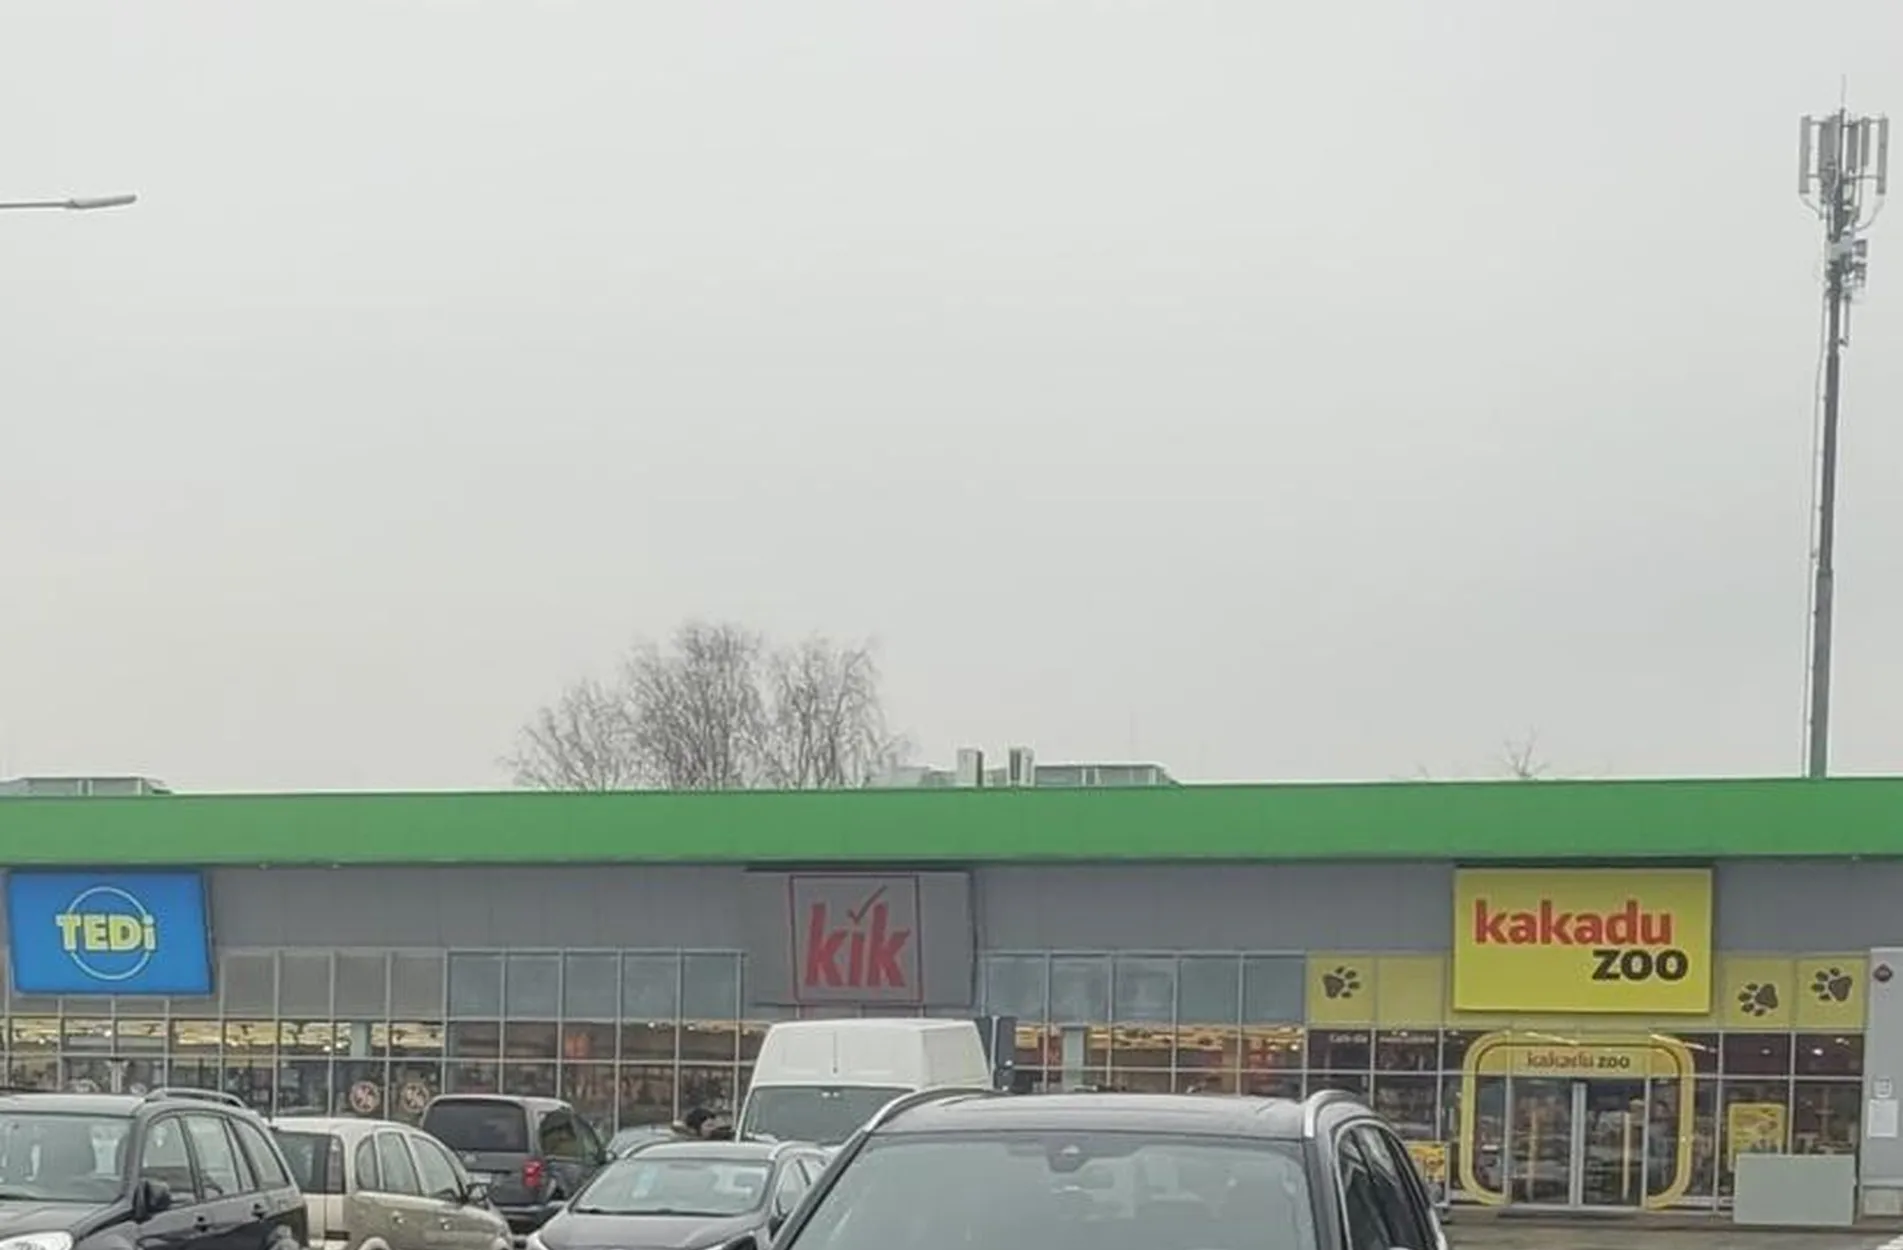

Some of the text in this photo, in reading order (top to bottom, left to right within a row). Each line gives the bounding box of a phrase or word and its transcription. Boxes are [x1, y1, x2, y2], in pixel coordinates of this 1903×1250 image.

[55, 913, 156, 951] TEDi
[1474, 898, 1673, 945] kakadu
[1527, 1049, 1594, 1068] kakadu
